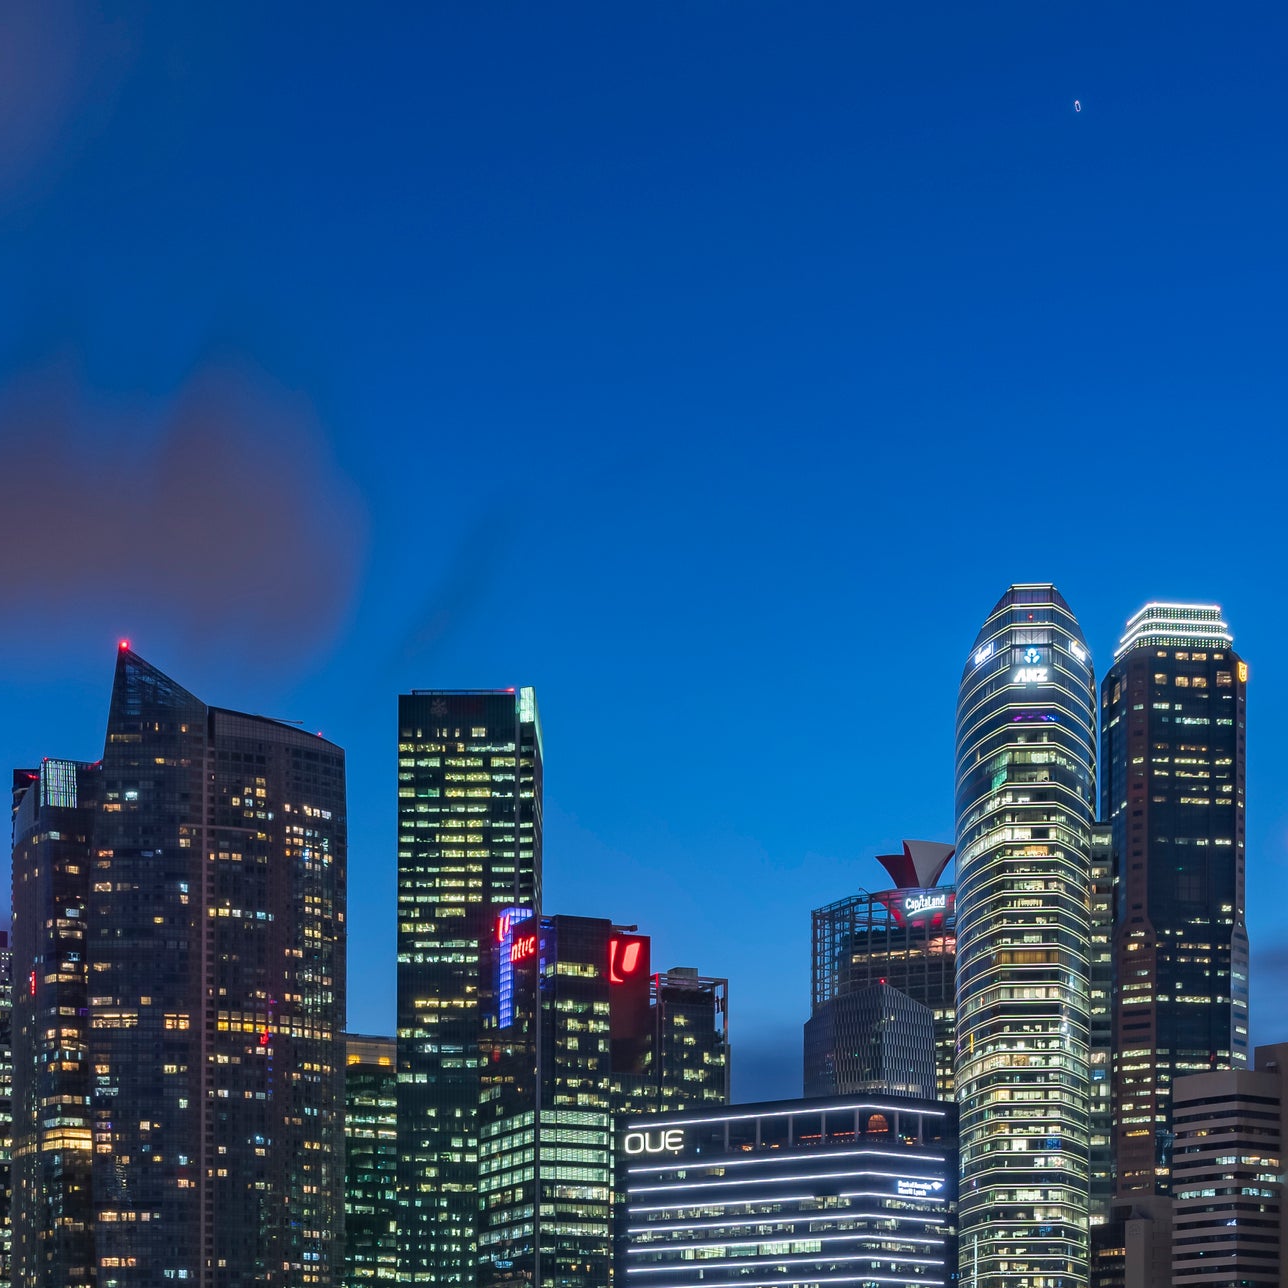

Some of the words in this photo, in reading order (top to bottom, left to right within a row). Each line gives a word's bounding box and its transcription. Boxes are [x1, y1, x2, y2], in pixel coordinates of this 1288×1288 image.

[1014, 668, 1048, 682] ANZ
[905, 894, 946, 911] CapitaLand
[510, 937, 536, 961] ntuc
[624, 1130, 684, 1154] OUE
